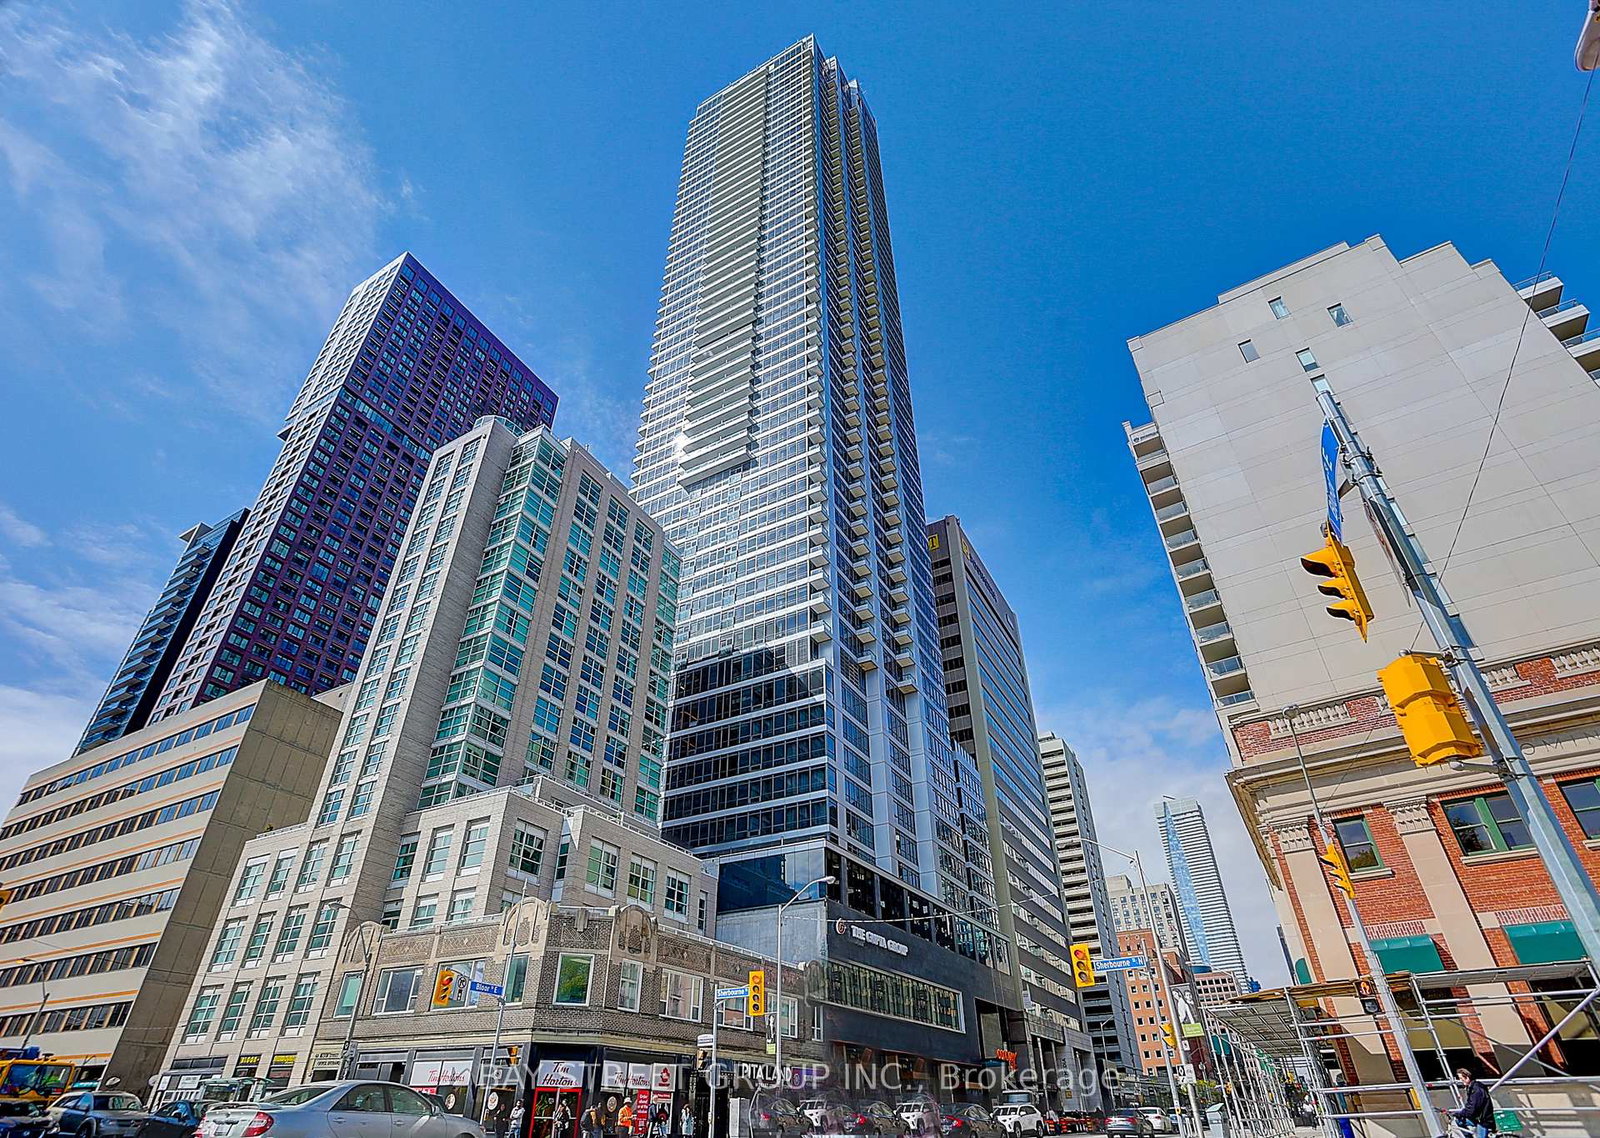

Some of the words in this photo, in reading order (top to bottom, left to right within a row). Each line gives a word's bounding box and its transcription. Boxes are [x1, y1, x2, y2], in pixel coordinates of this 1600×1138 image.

[1096, 959, 1131, 970] Sherbourne
[1138, 956, 1144, 965] N
[494, 986, 498, 994] E
[717, 988, 745, 997] Sherbourne
[553, 1061, 570, 1073] Tim
[542, 1073, 579, 1086] Hortons
